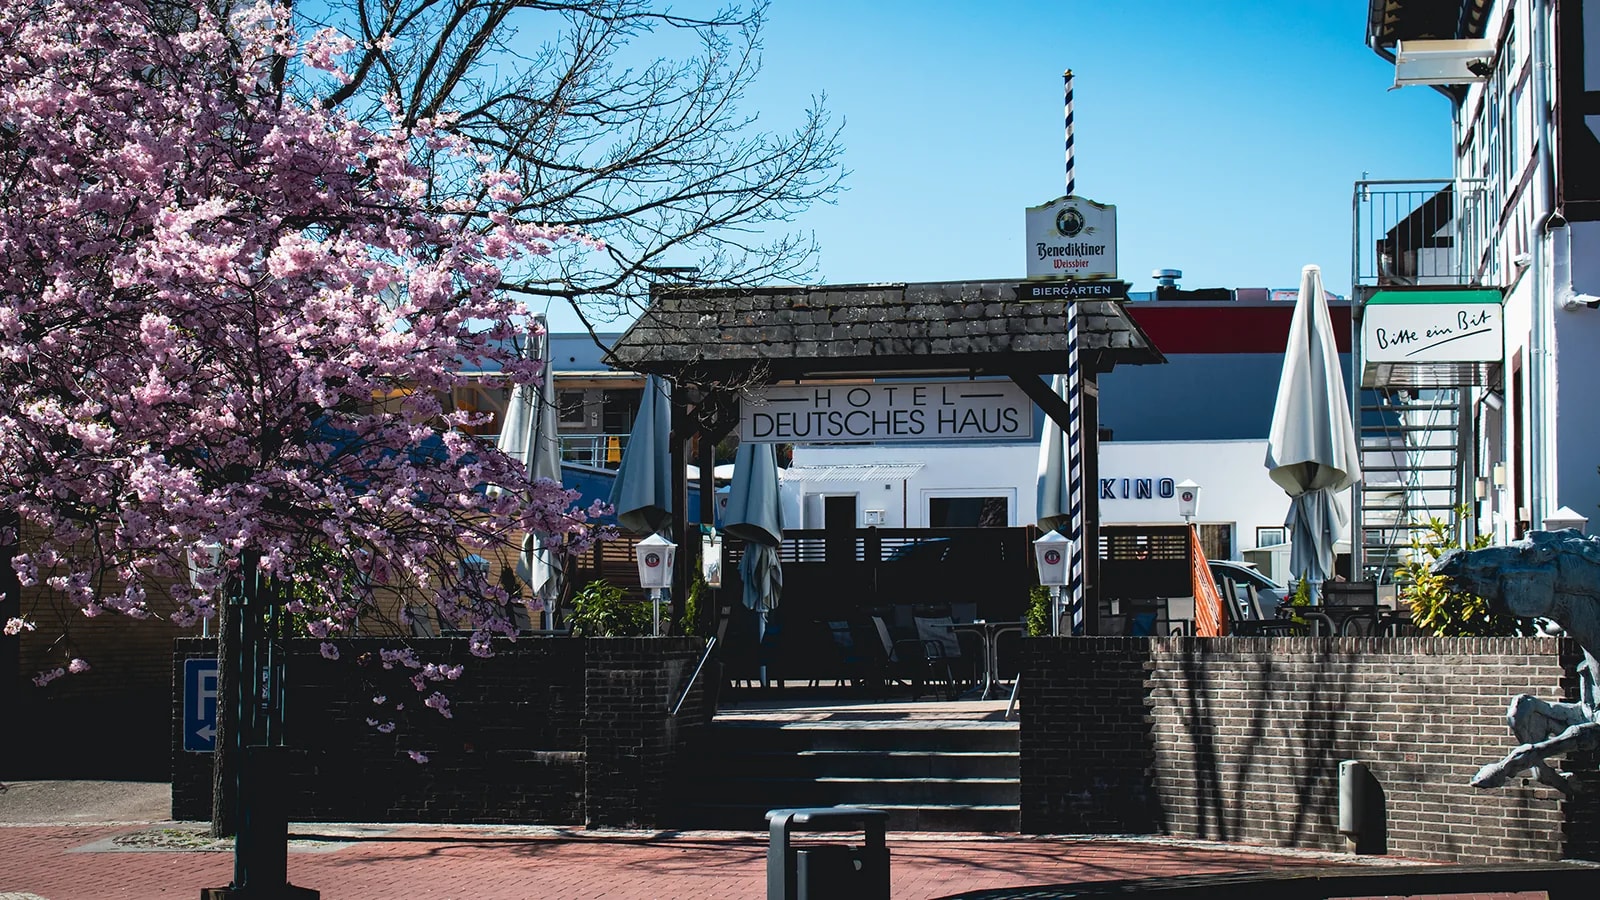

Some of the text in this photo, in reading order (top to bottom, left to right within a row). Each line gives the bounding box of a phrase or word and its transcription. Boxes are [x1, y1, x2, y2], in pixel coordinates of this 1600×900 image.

[1036, 242, 1106, 260] Benediktiner
[1053, 259, 1090, 269] Weissbier
[1032, 286, 1111, 296] BIERGARTEN
[1376, 310, 1492, 350] Bitte ein Bit
[815, 386, 955, 408] HOTEL
[753, 407, 1019, 438] DEUTSCHES HAUS
[1100, 478, 1175, 499] KINO
